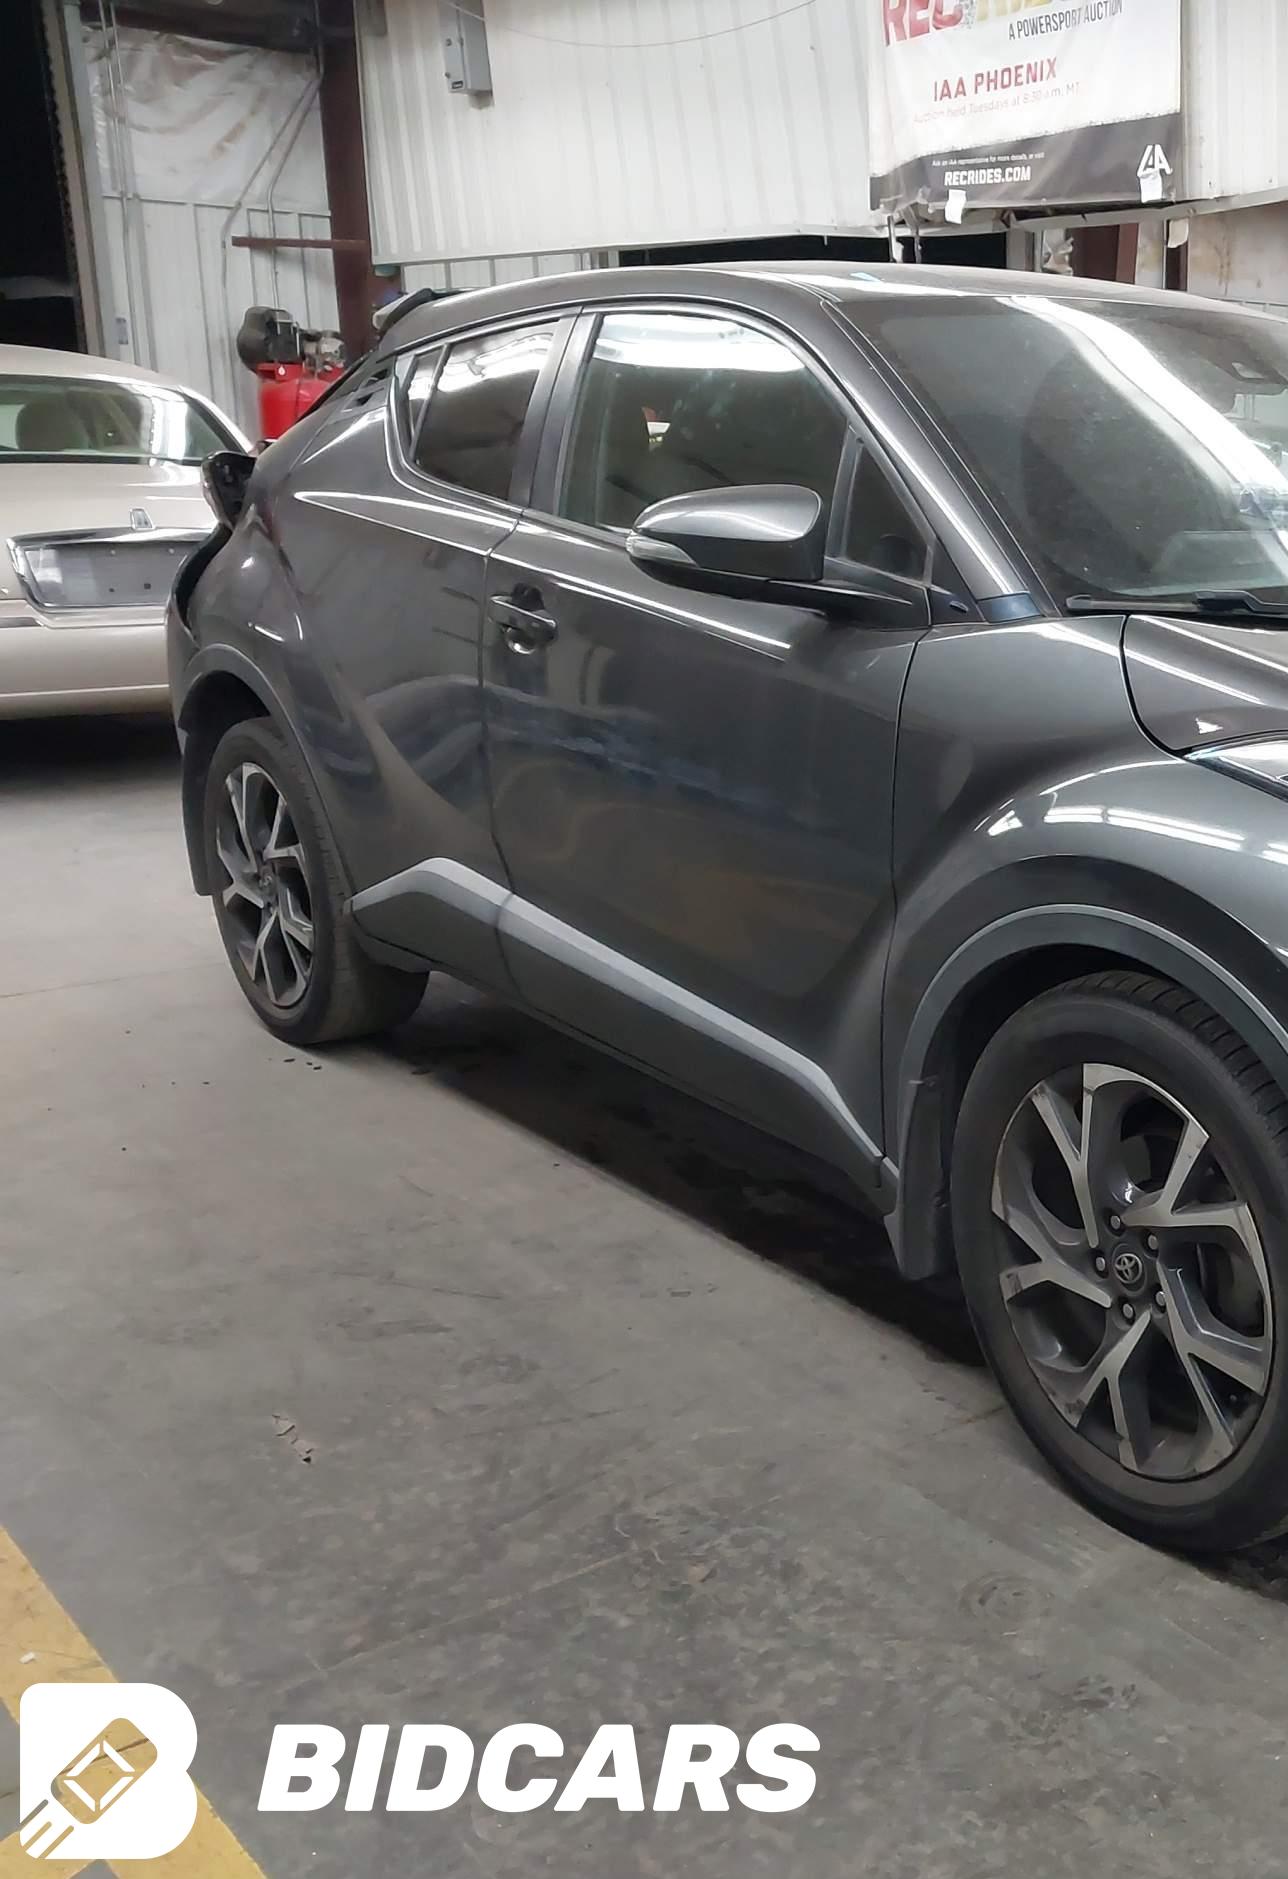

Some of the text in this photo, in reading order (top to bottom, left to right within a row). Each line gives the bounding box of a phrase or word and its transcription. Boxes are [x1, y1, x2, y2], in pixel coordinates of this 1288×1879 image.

[1009, 23, 1016, 40] A
[1017, 8, 1081, 39] POWERSPORT
[934, 57, 1057, 102] IAA PHOENIX
[944, 165, 1031, 186] RECRIDES.COM
